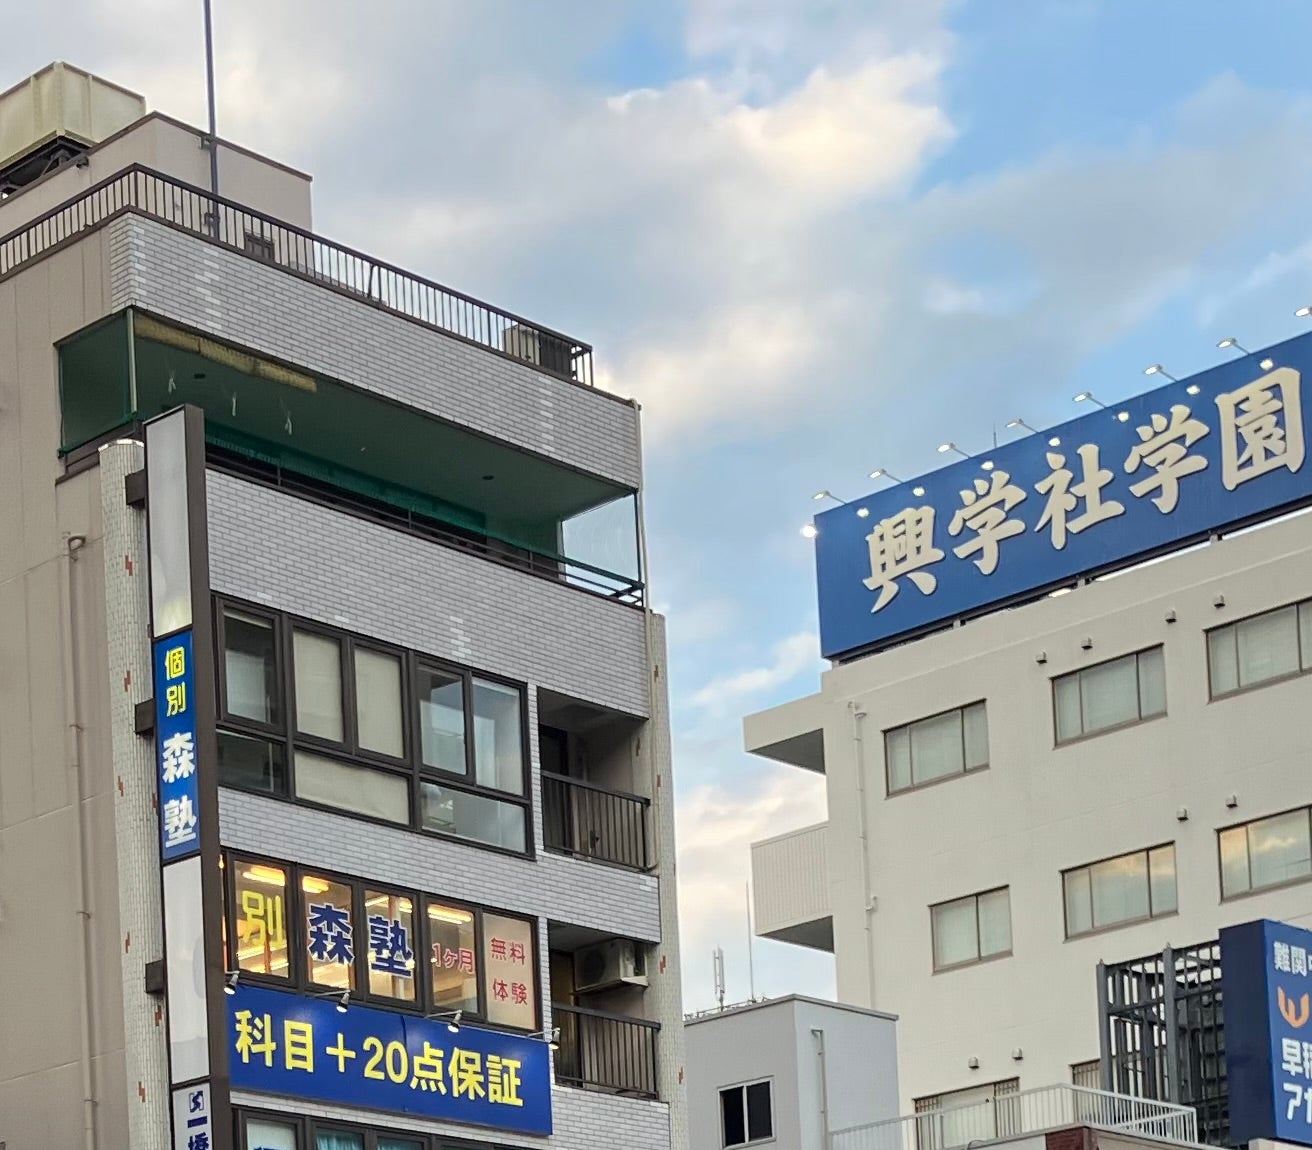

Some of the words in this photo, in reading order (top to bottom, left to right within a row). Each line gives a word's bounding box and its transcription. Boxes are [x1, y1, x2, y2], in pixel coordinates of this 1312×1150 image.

[862, 366, 1306, 614] 興学社学園
[165, 646, 187, 717] 個別
[162, 731, 197, 848] 森塾
[490, 937, 526, 966] 無料
[492, 978, 528, 1006] 体験
